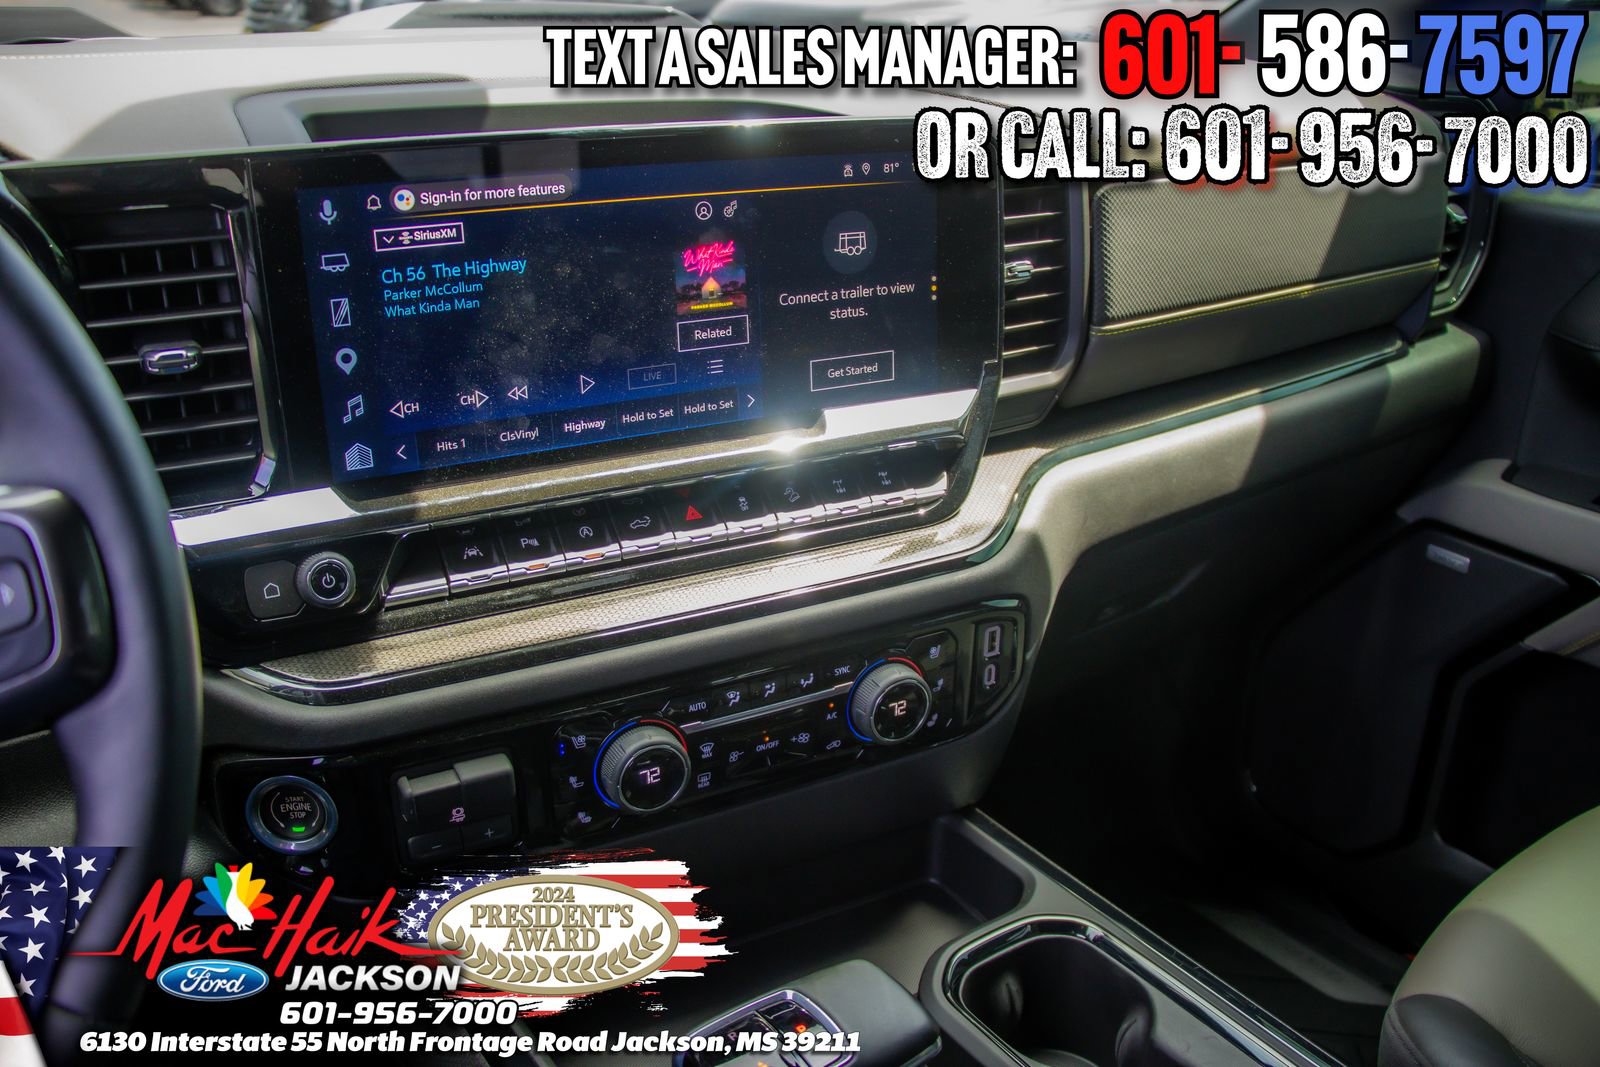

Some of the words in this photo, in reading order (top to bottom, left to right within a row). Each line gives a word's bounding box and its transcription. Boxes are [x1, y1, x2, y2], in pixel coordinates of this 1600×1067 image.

[883, 162, 900, 173] 81°
[420, 189, 462, 206] Sign-in
[464, 187, 481, 201] for
[484, 188, 515, 199] more
[517, 182, 566, 197] features
[414, 228, 457, 241] SiriusXM
[382, 267, 402, 284] Ch
[407, 266, 426, 281] 56
[432, 263, 461, 279] The
[465, 258, 527, 277] Highway
[384, 287, 421, 301] Parker
[425, 282, 483, 297] McCollum
[779, 290, 828, 306] Connect
[832, 291, 838, 301] a
[841, 285, 873, 299] trailer
[877, 285, 888, 296] to
[889, 282, 915, 295] view
[384, 304, 416, 318] What
[419, 301, 451, 314] Kinda
[454, 298, 480, 310] Man
[830, 306, 868, 320] status.
[695, 326, 732, 341] Related
[643, 370, 662, 382] LIVE
[827, 367, 843, 378] Get
[846, 362, 878, 376] Started
[460, 394, 475, 406] CH
[684, 403, 705, 415] Hold
[707, 402, 716, 412] to
[718, 399, 734, 411] Set
[404, 402, 420, 414] CH
[622, 411, 645, 424] Hold
[648, 410, 657, 421] to
[659, 408, 674, 420] Set
[564, 418, 606, 434] Highway
[500, 427, 539, 442] ClsVinyl
[436, 439, 458, 452] Hits
[460, 438, 466, 449] 1
[834, 666, 851, 676] SYNC
[689, 701, 707, 713] AUTO
[888, 700, 908, 717] 72
[826, 711, 838, 720] A/C
[756, 739, 780, 752] ON/OFF
[639, 767, 661, 784] 72
[280, 801, 312, 813] ENGINE
[289, 811, 306, 819] STOP
